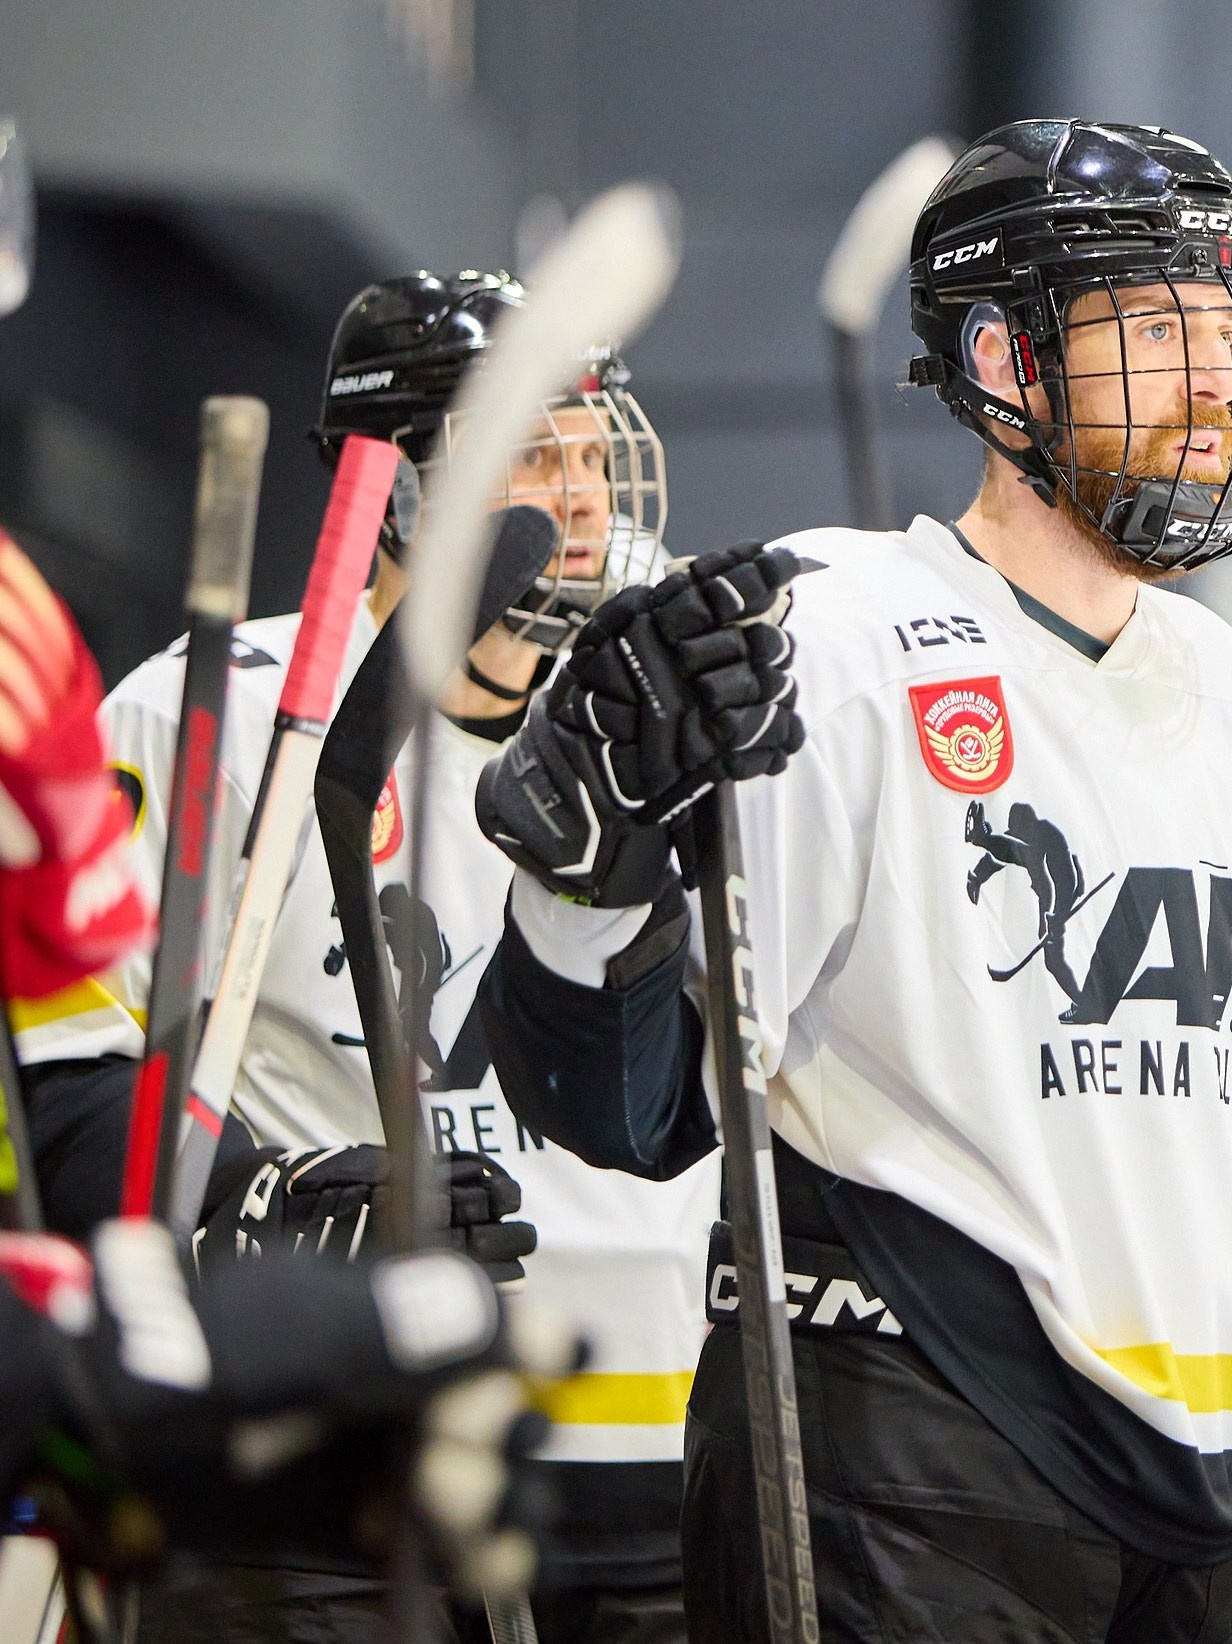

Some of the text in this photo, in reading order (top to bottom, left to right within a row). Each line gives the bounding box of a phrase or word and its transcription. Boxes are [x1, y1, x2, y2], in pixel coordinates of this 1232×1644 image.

[932, 237, 999, 271] CCM
[330, 369, 395, 397] BAUER
[1018, 334, 1038, 383] CCM
[983, 403, 1026, 429] CCM
[923, 689, 1000, 725] ХОККЕЙНАЯ ЛИГА
[726, 873, 768, 1096] CCM
[1040, 1037, 1191, 1100] ARENA
[431, 1104, 545, 1155] REN
[709, 1263, 904, 1336] CCM
[736, 1230, 793, 1633] JETSPEED
[778, 1374, 819, 1644] JETSPEED
